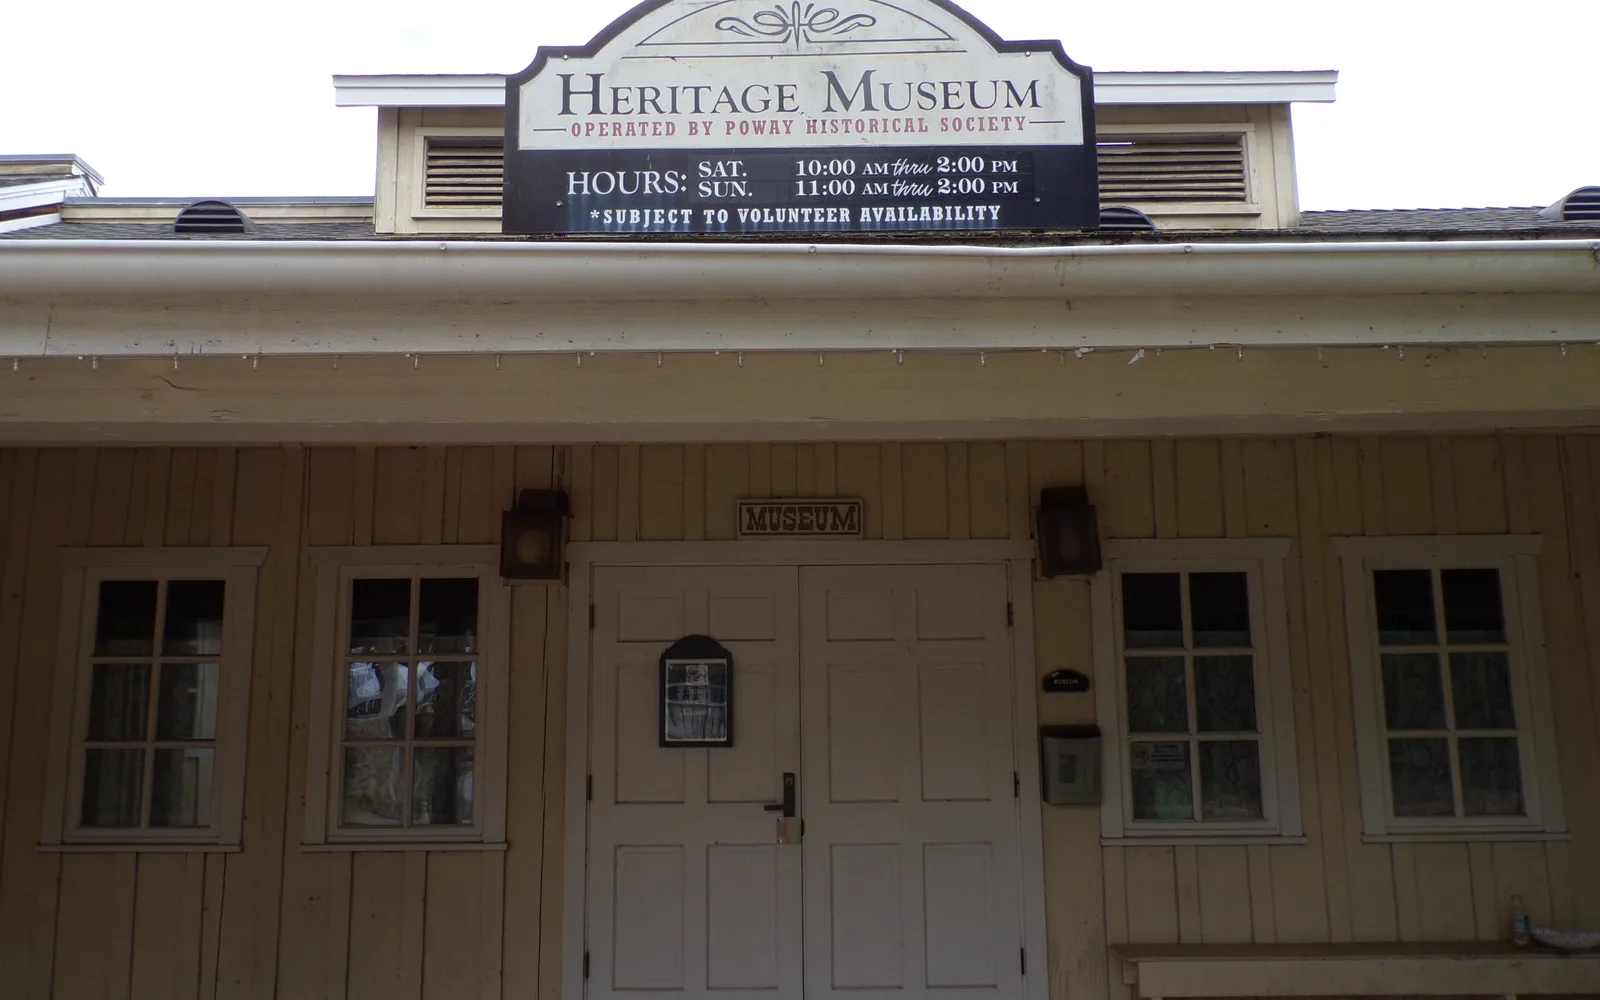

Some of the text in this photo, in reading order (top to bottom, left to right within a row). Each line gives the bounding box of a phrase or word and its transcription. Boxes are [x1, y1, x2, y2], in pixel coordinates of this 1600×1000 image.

[556, 69, 1042, 116] HERITAGE MUSEUM
[571, 116, 1026, 137] OPERATED BY POWAY HISTORICAL SOCIETY
[698, 156, 1018, 178] SAT. 10:00 AM thru 2:00 PM
[566, 170, 687, 195] HOURS:
[698, 178, 1019, 198] SUN. 11:00 AM thru 2:00 PM
[703, 210, 729, 224] TO
[738, 207, 850, 224] VOLUNTEER
[860, 205, 1001, 223] AVAILABILITY
[746, 505, 856, 531] MUSEUM
